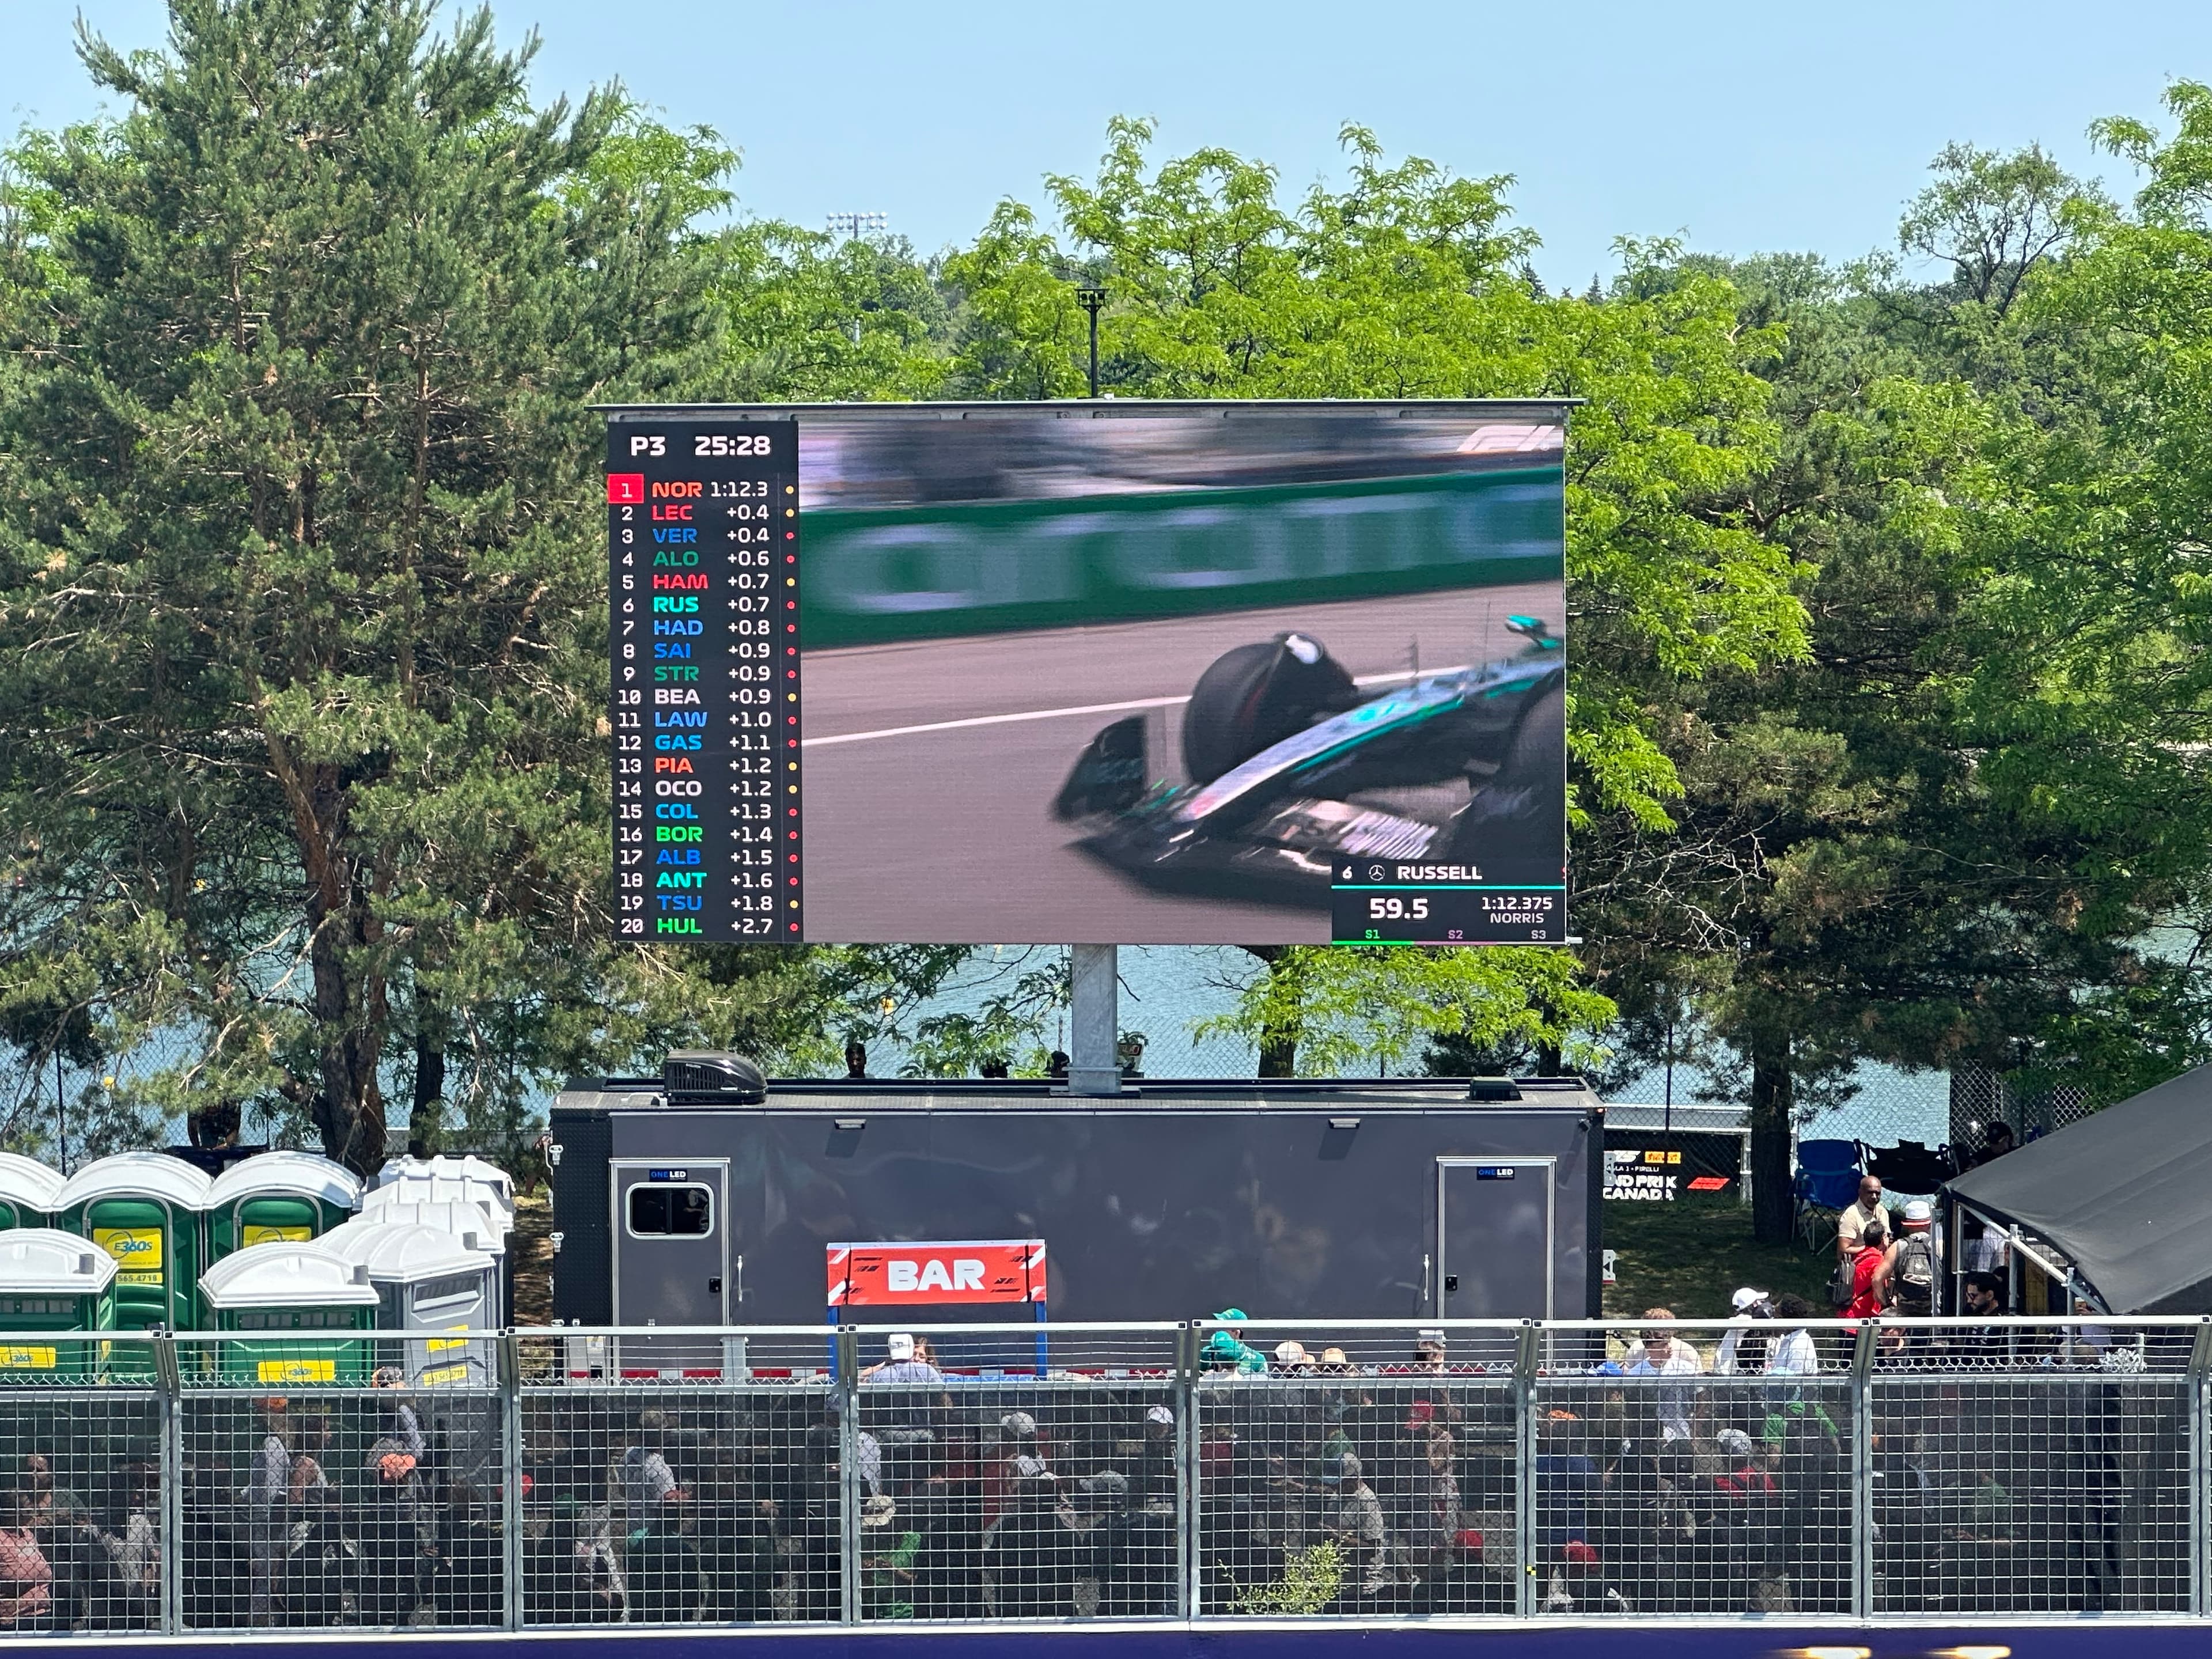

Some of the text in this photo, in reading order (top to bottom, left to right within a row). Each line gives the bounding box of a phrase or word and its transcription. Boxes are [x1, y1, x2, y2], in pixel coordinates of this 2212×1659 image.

[631, 435, 771, 456] P3 25:28
[622, 482, 767, 498] 1 NOR 1:12.3
[622, 505, 769, 521] 2 LEC +0.4
[622, 528, 770, 544] 3 VER +0.4
[623, 551, 769, 566] 4 ALO +0.6
[623, 574, 769, 590] 5 HAM +0.7
[623, 597, 769, 612] 6 RUS +0.7
[623, 620, 770, 635] 7 HAD +0.8
[623, 643, 770, 659] 8 SAI +0.9
[624, 666, 771, 681] 9 STR +0.9
[619, 689, 771, 705] 10 BEA +0.9
[619, 711, 771, 728] 11 LAW +1.0
[619, 735, 770, 750] 12 GAS +1.1
[619, 757, 771, 773] 13 PIA +1.2
[620, 781, 771, 797] 14 OCO +1.2
[620, 804, 771, 819] 15 COL +1.3
[620, 827, 772, 843] 16 BOR +1.4
[620, 850, 772, 865] 17 ALB +1.5
[621, 872, 772, 888] 18 ANT +1.6
[1342, 864, 1484, 880] 6 RUSSELL
[621, 895, 772, 911] 19 TSU +1.8
[1370, 896, 1429, 920] 59.5
[1482, 896, 1552, 910] 1:12.375
[622, 918, 772, 933] 20 HUL +2.7
[1490, 912, 1544, 923] NORRIS
[1365, 929, 1546, 940] S1 S2 S3
[1603, 1187, 1675, 1200] CANADA
[888, 1259, 985, 1291] BAR
